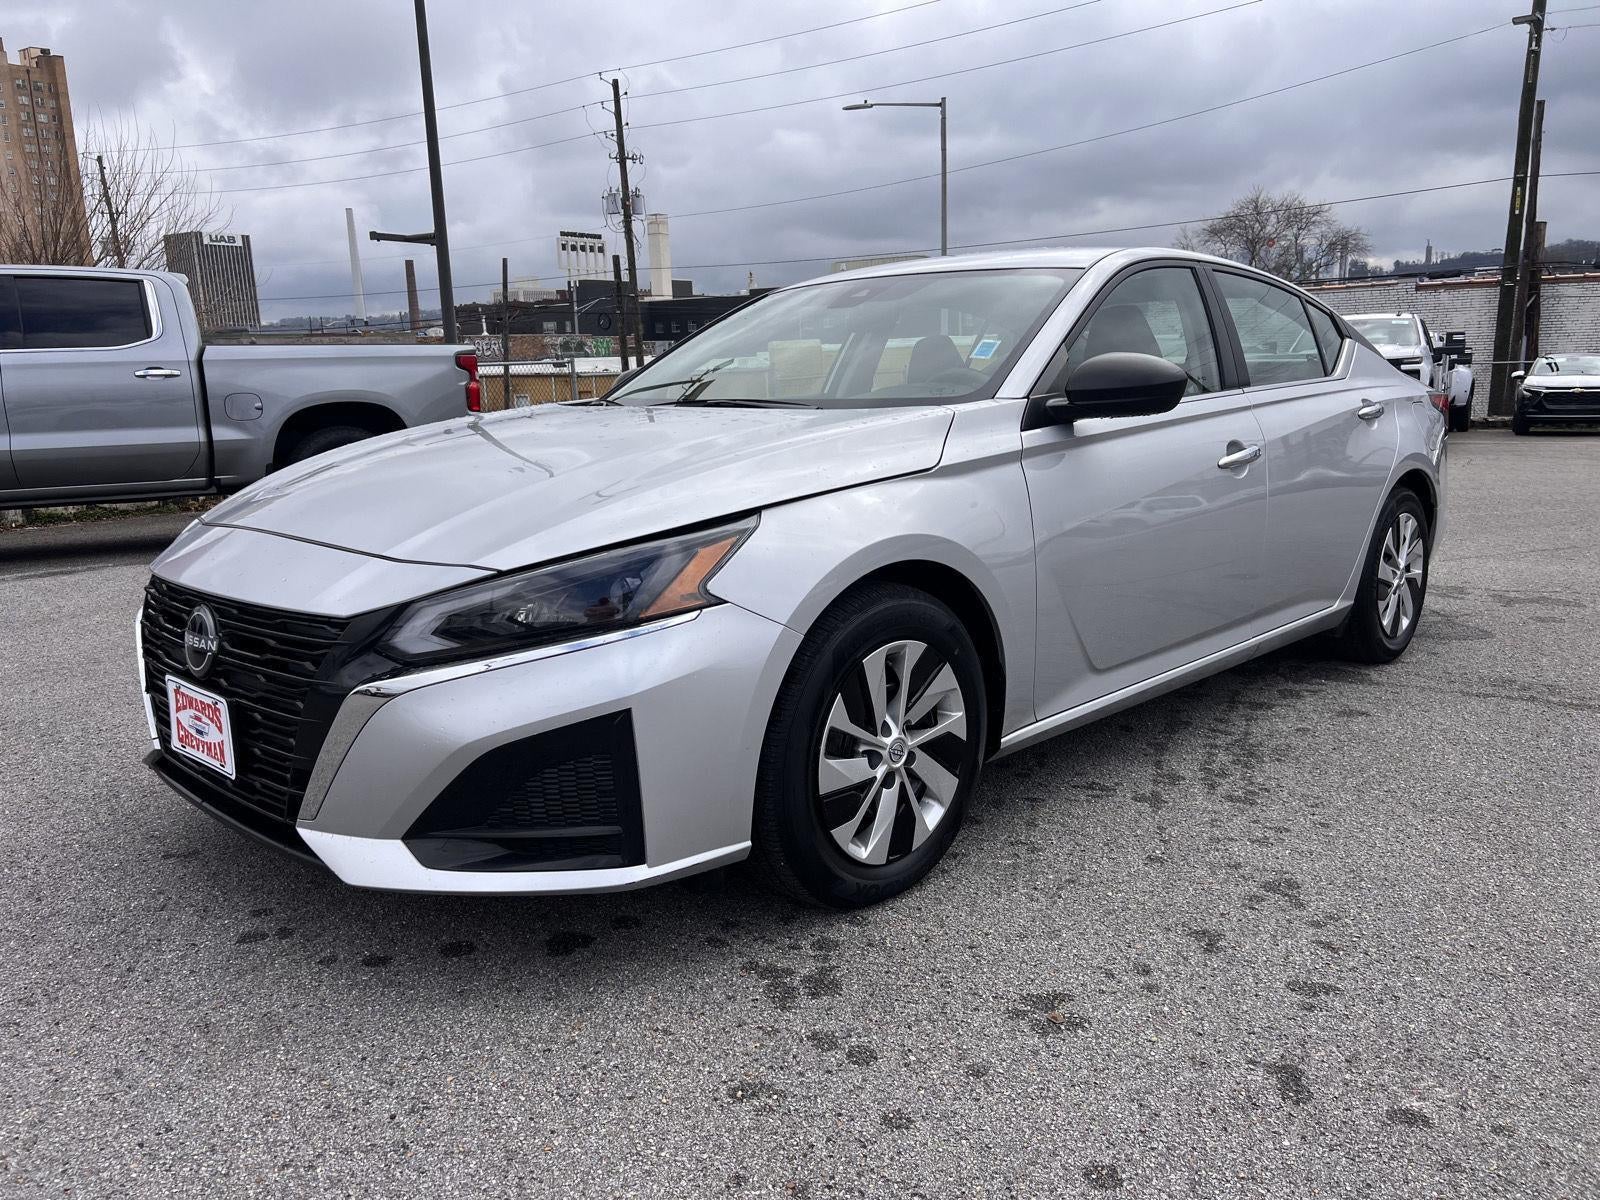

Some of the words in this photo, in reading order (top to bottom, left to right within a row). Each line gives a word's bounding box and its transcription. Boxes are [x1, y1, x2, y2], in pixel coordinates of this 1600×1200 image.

[209, 234, 236, 244] UAB
[186, 634, 217, 651] SSAN
[174, 688, 223, 735] EDWARDS
[176, 716, 226, 765] CHEVYMAN
